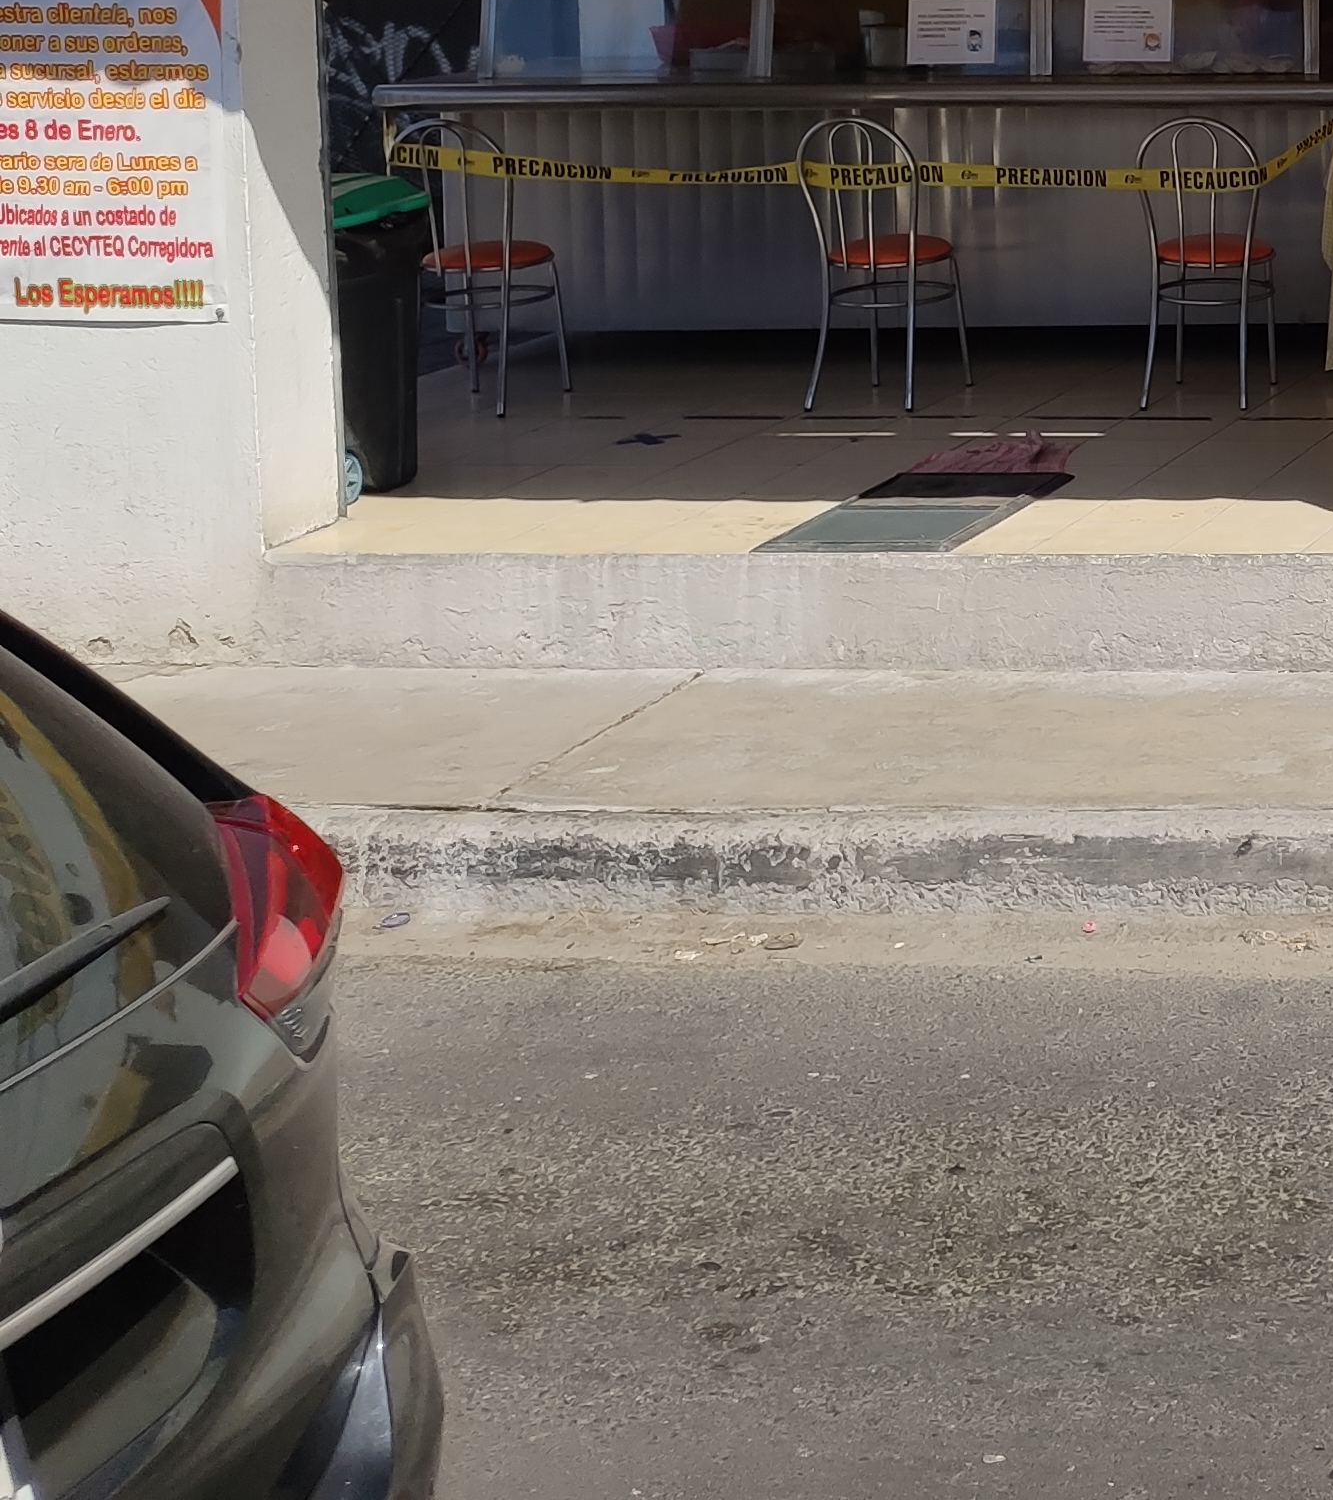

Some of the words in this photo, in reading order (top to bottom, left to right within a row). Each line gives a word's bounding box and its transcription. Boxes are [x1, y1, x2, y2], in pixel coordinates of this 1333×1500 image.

[46, 3, 134, 28] clientela,
[138, 7, 177, 24] nos
[48, 35, 61, 52] a
[64, 34, 99, 52] sus
[103, 31, 188, 56] ordenes,
[10, 60, 100, 83] sucursal,
[105, 60, 209, 80] estaremos
[7, 88, 84, 109] servicio
[89, 87, 145, 109] desde
[149, 88, 169, 109] el
[174, 86, 206, 109] día
[25, 119, 38, 140] 8
[44, 119, 71, 140] de
[78, 119, 141, 141] Enero.
[44, 155, 86, 171] sera
[90, 152, 113, 171] de
[117, 152, 181, 171] Lunes
[185, 156, 198, 171] a
[492, 156, 611, 179] PRECAUCION
[831, 165, 943, 186] PRECAUCON
[996, 167, 1107, 187] PRECAUCION
[17, 176, 60, 195] 9.30
[63, 181, 90, 195] am
[106, 176, 153, 195] 6:00
[157, 180, 188, 199] pm
[61, 211, 69, 226] a
[73, 210, 92, 226] un
[96, 204, 155, 226] costado
[160, 205, 176, 226] de
[34, 236, 46, 257] al
[50, 235, 124, 257] CECYTEQ
[128, 235, 213, 263] Corregidora
[14, 276, 54, 307] Los
